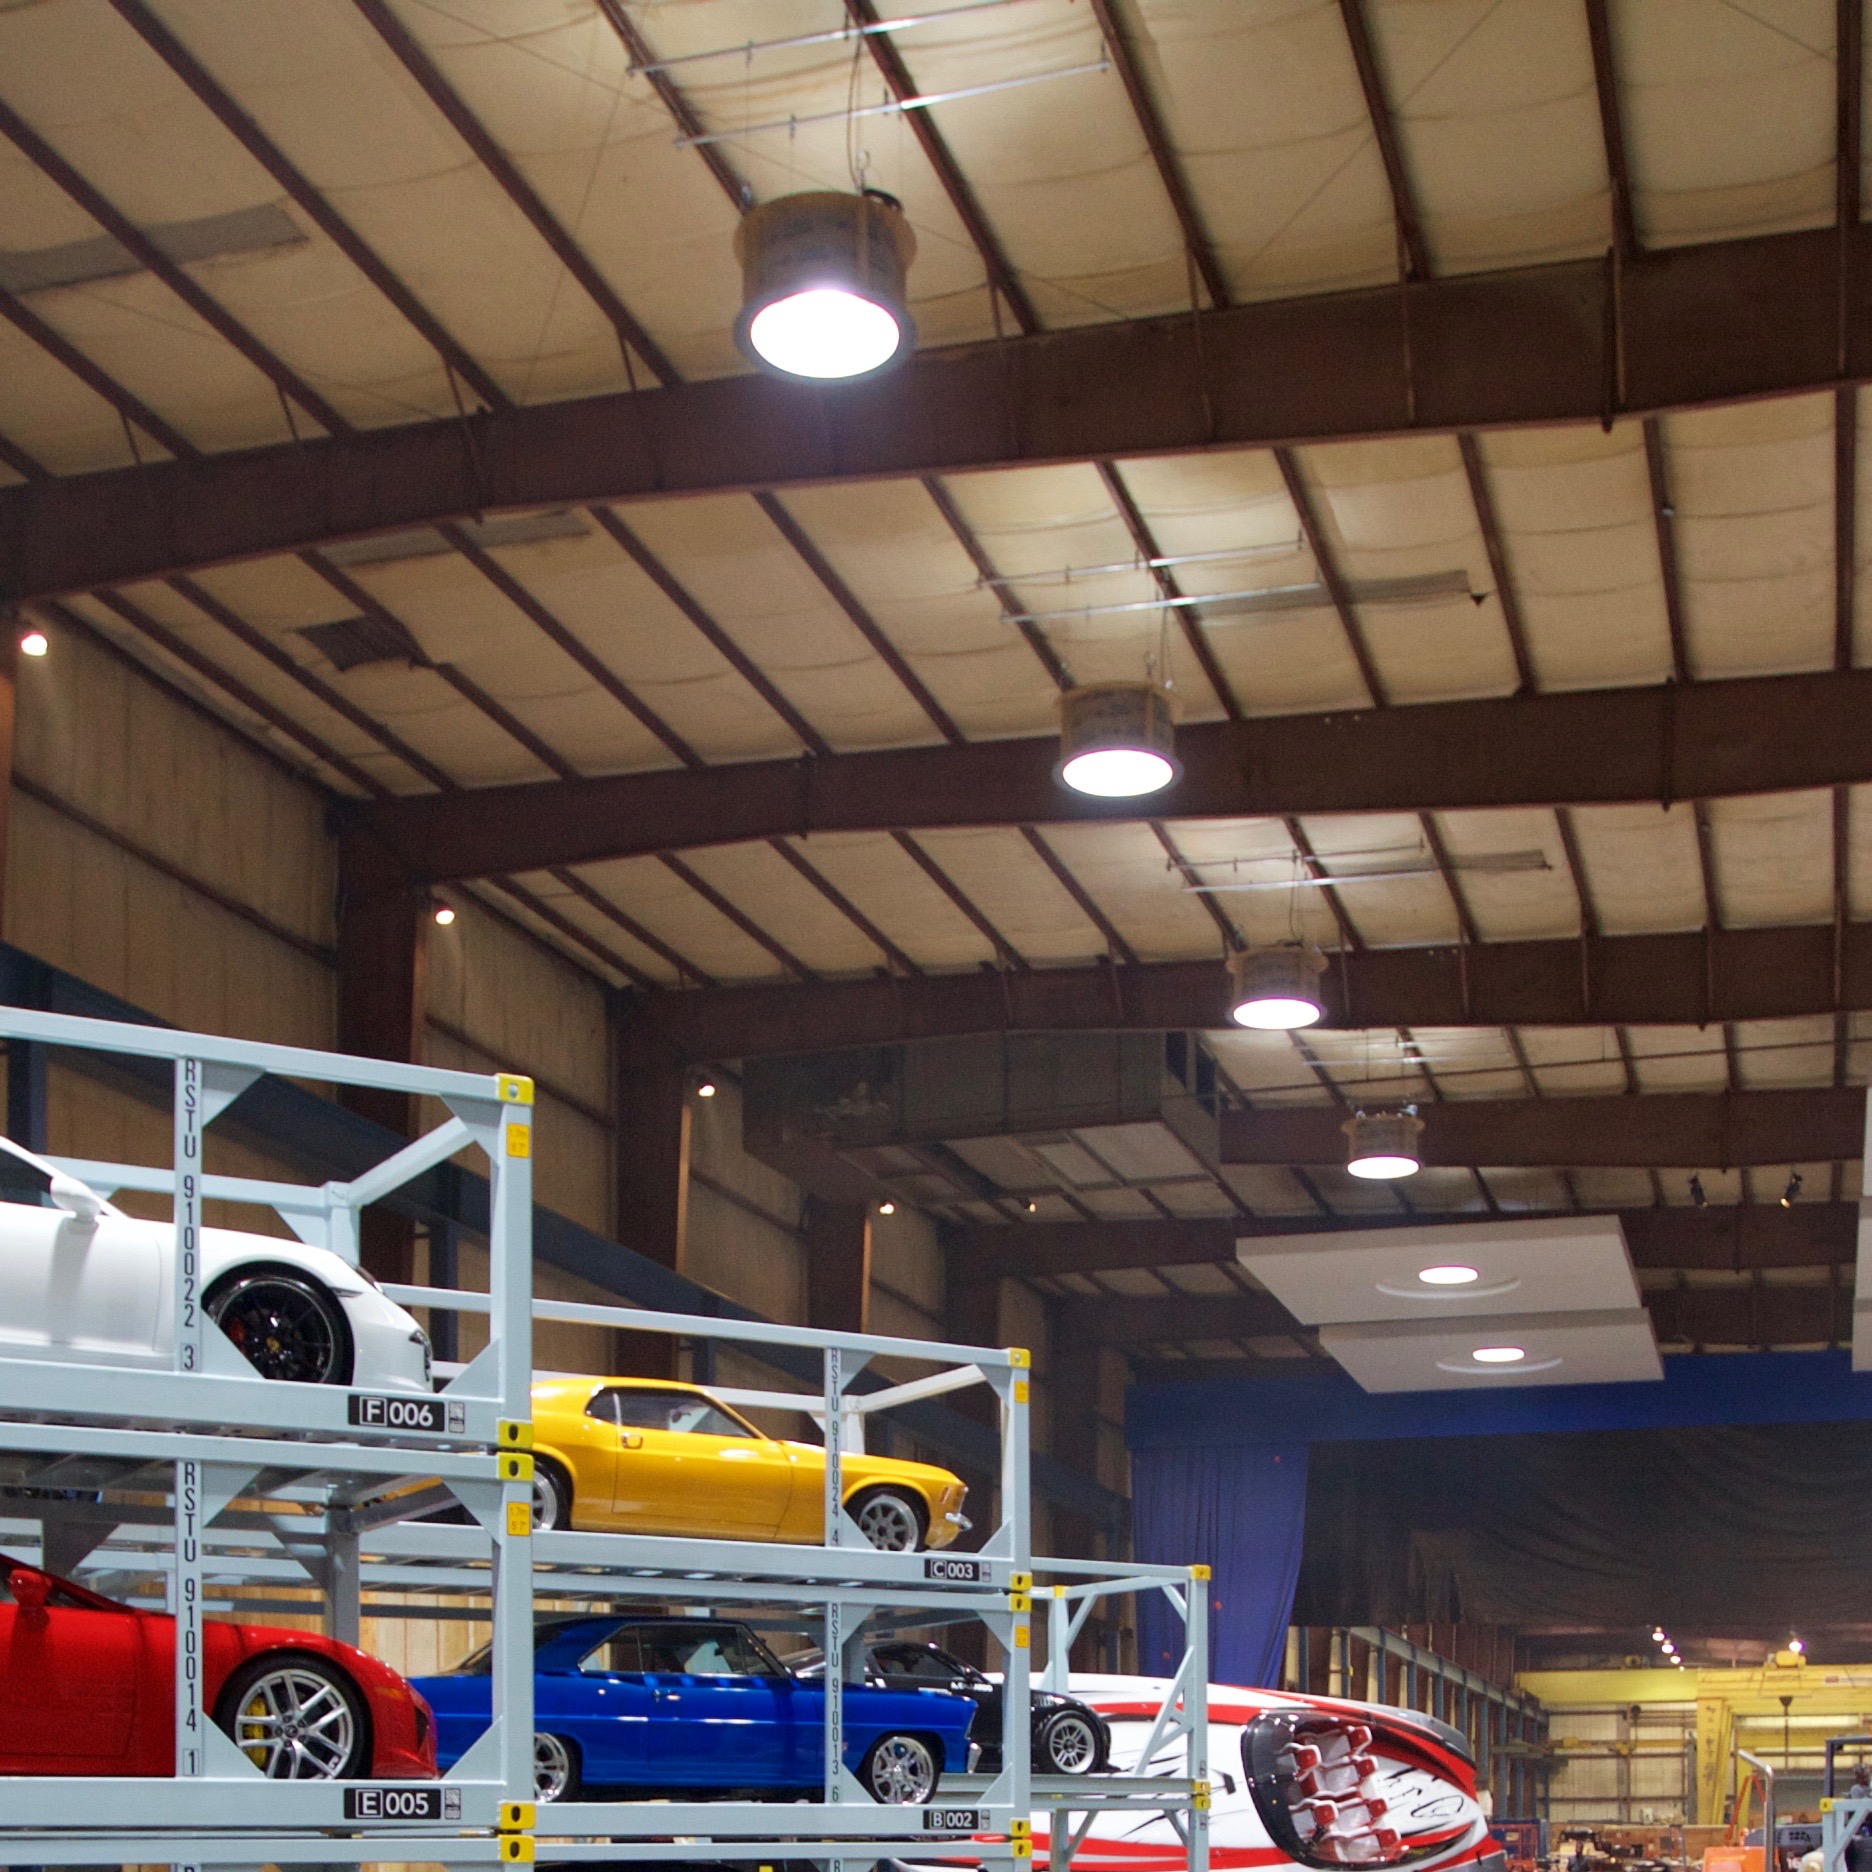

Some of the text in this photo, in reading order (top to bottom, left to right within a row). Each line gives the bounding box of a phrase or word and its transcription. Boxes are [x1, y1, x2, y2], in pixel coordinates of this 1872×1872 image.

[184, 1058, 196, 1159] RSTU
[184, 1174, 196, 1328] 910022
[184, 1461, 196, 1563] RSTU
[184, 1577, 197, 1732] 910014
